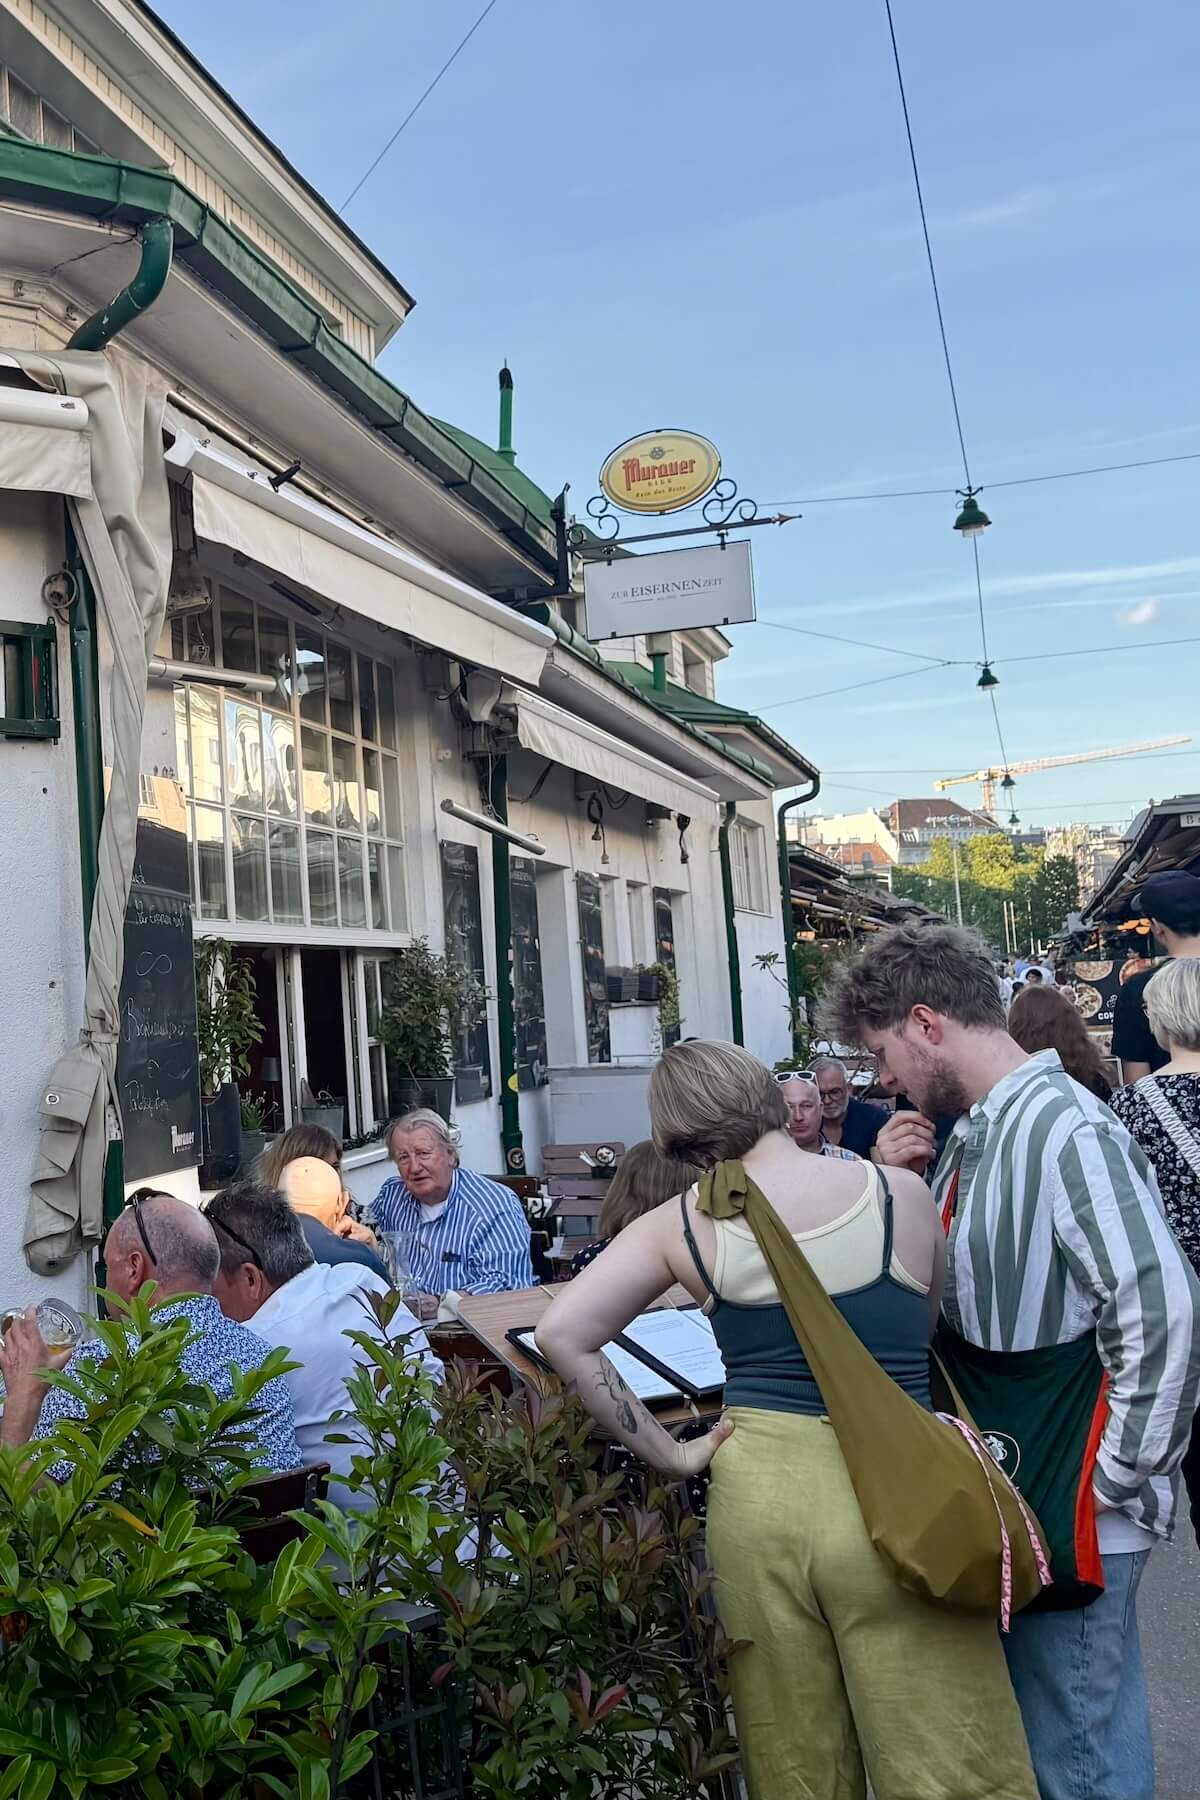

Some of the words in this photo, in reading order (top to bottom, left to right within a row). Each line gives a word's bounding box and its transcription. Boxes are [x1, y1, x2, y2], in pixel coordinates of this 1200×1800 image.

[622, 458, 696, 491] Murauer
[610, 590, 629, 600] ZUR
[631, 579, 701, 597] EISERNEN
[702, 577, 722, 587] ZEIT
